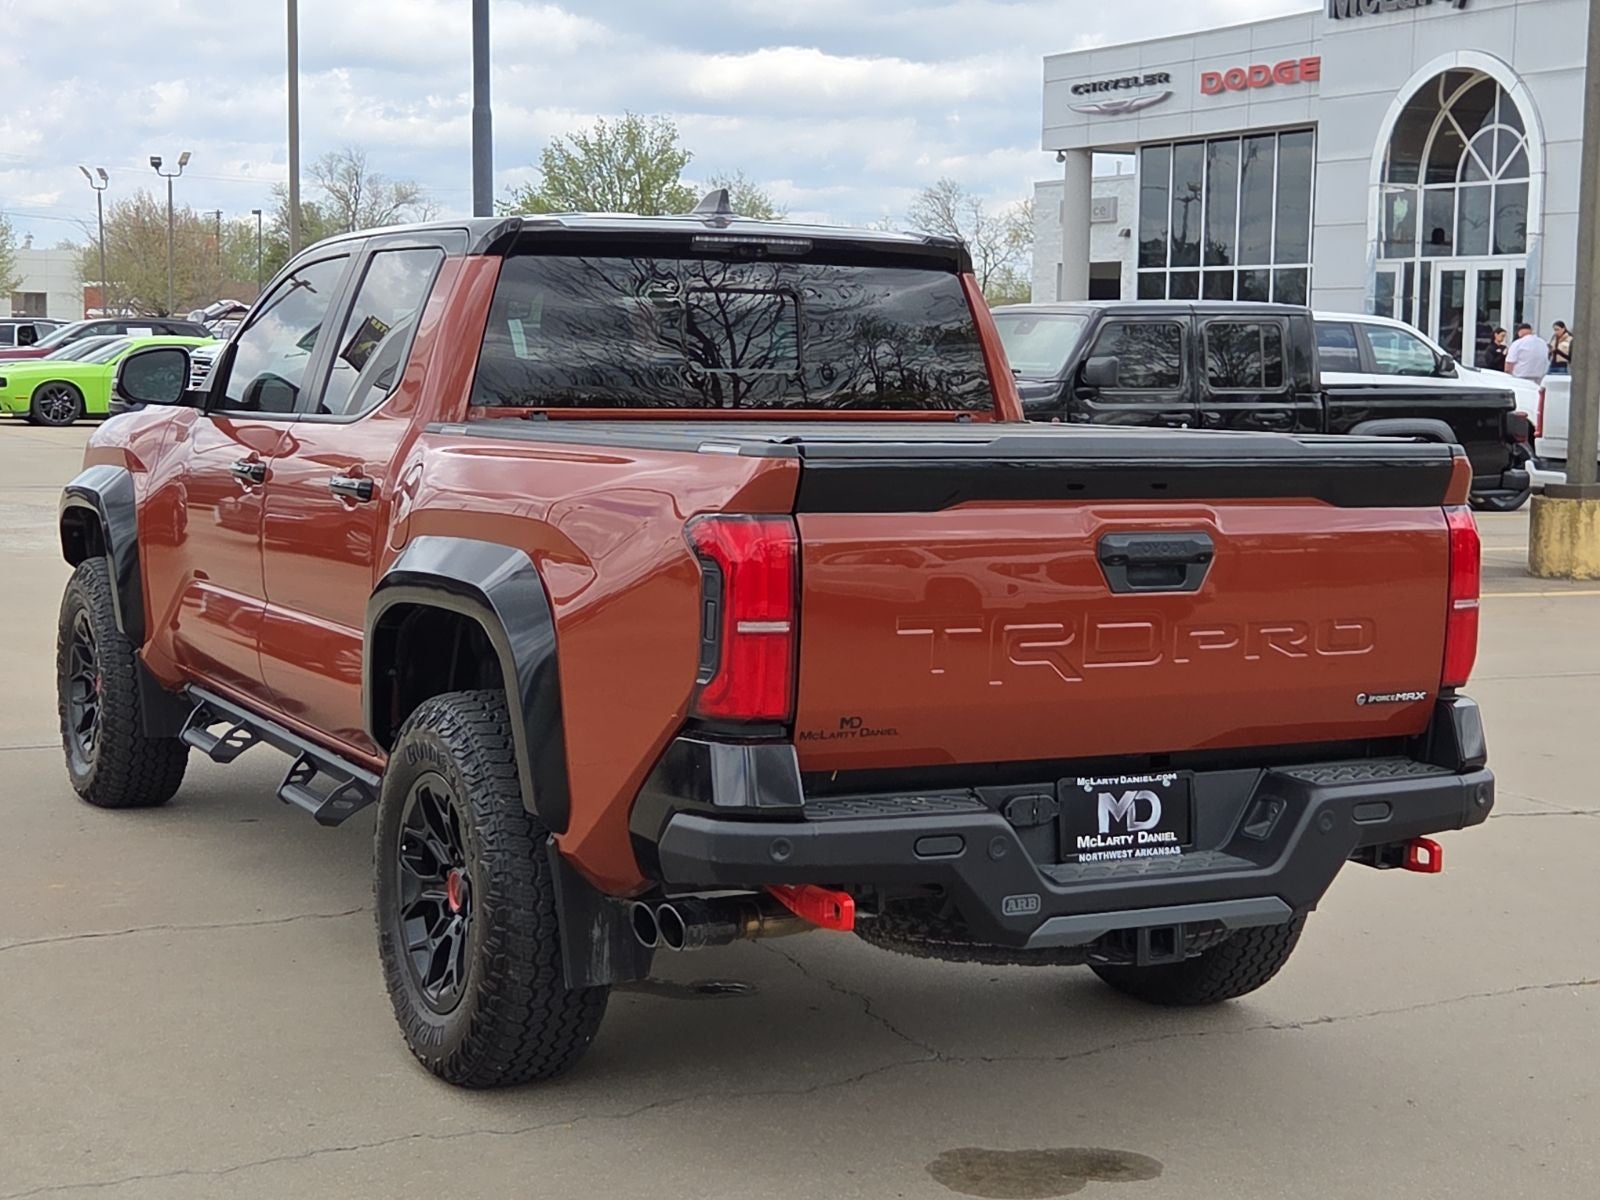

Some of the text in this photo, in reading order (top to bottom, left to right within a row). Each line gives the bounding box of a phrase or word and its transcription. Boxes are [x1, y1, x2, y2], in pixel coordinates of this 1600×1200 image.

[1071, 72, 1170, 95] CHRYSLER
[1200, 56, 1321, 95] DODGE
[1097, 790, 1162, 833] MD
[1138, 831, 1177, 844] DANIEL
[1078, 846, 1181, 862] NORTHWEST ARKANSAS
[1006, 898, 1038, 912] ARB
